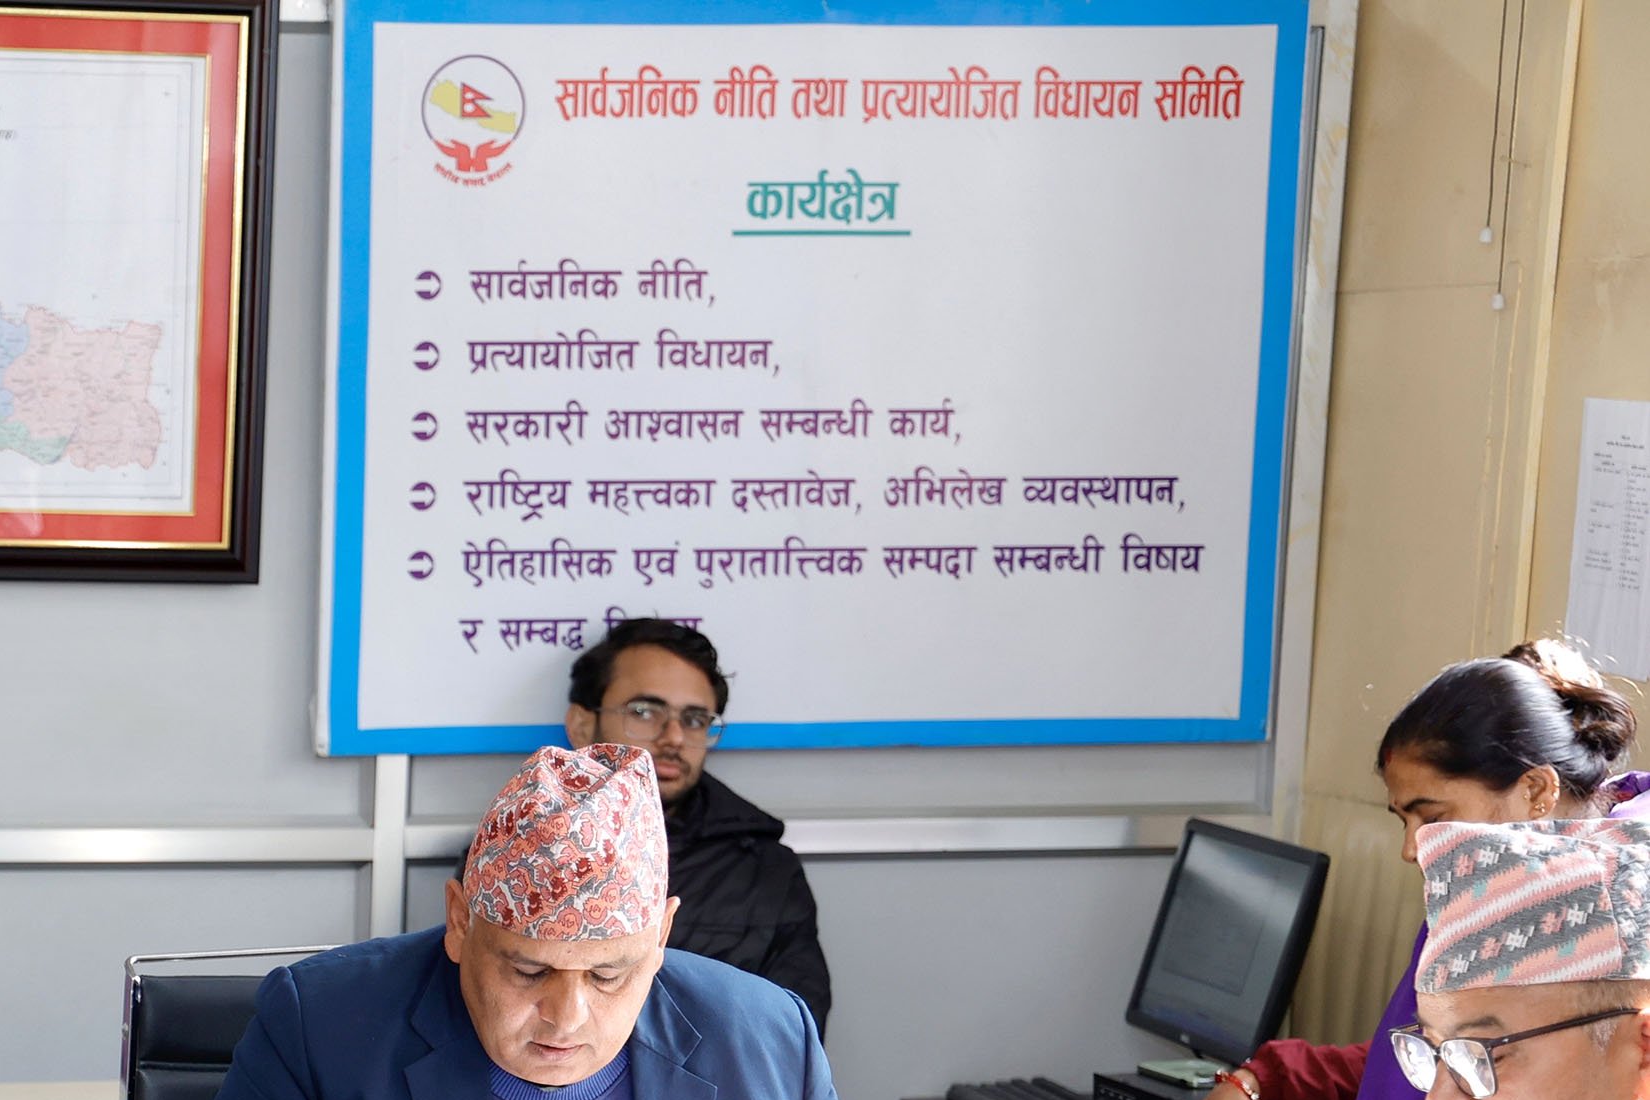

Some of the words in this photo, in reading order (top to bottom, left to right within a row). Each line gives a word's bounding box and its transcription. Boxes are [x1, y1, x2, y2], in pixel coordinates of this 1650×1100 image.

[556, 65, 700, 120] सार्वजनिक
[714, 65, 779, 119] नीति
[792, 78, 848, 119] तथा
[862, 66, 1021, 124] प्रत्यायोजित
[1035, 66, 1143, 119] विधायन
[1154, 64, 1246, 122] समिति
[747, 169, 899, 224] कार्यक्षेत्र
[469, 259, 622, 303] सार्वजनिक
[637, 258, 715, 305] नीति,
[467, 329, 640, 375] प्रत्यायोजित
[655, 329, 779, 377] विधायन,
[465, 400, 589, 445] सरकारी
[605, 409, 744, 443] आश्वासन
[760, 398, 873, 442] सम्बन्धी
[888, 398, 962, 445] कार्य,
[463, 469, 572, 522] राष्ट्रिय
[587, 480, 716, 516] महत्त्वका
[731, 469, 862, 515] दस्तावेज,
[884, 466, 1008, 509] अभिलेख
[1022, 475, 1186, 513] व्यवस्थापन,
[462, 538, 617, 587] ऐतिहासिक
[632, 540, 680, 586] एवं
[693, 535, 868, 590] पुरातात्त्विक
[883, 546, 978, 580] सम्पदा
[993, 534, 1106, 579] सम्बन्धी
[1119, 532, 1206, 574] विषय
[459, 619, 484, 654] र
[498, 618, 588, 652] सम्बद्ध
